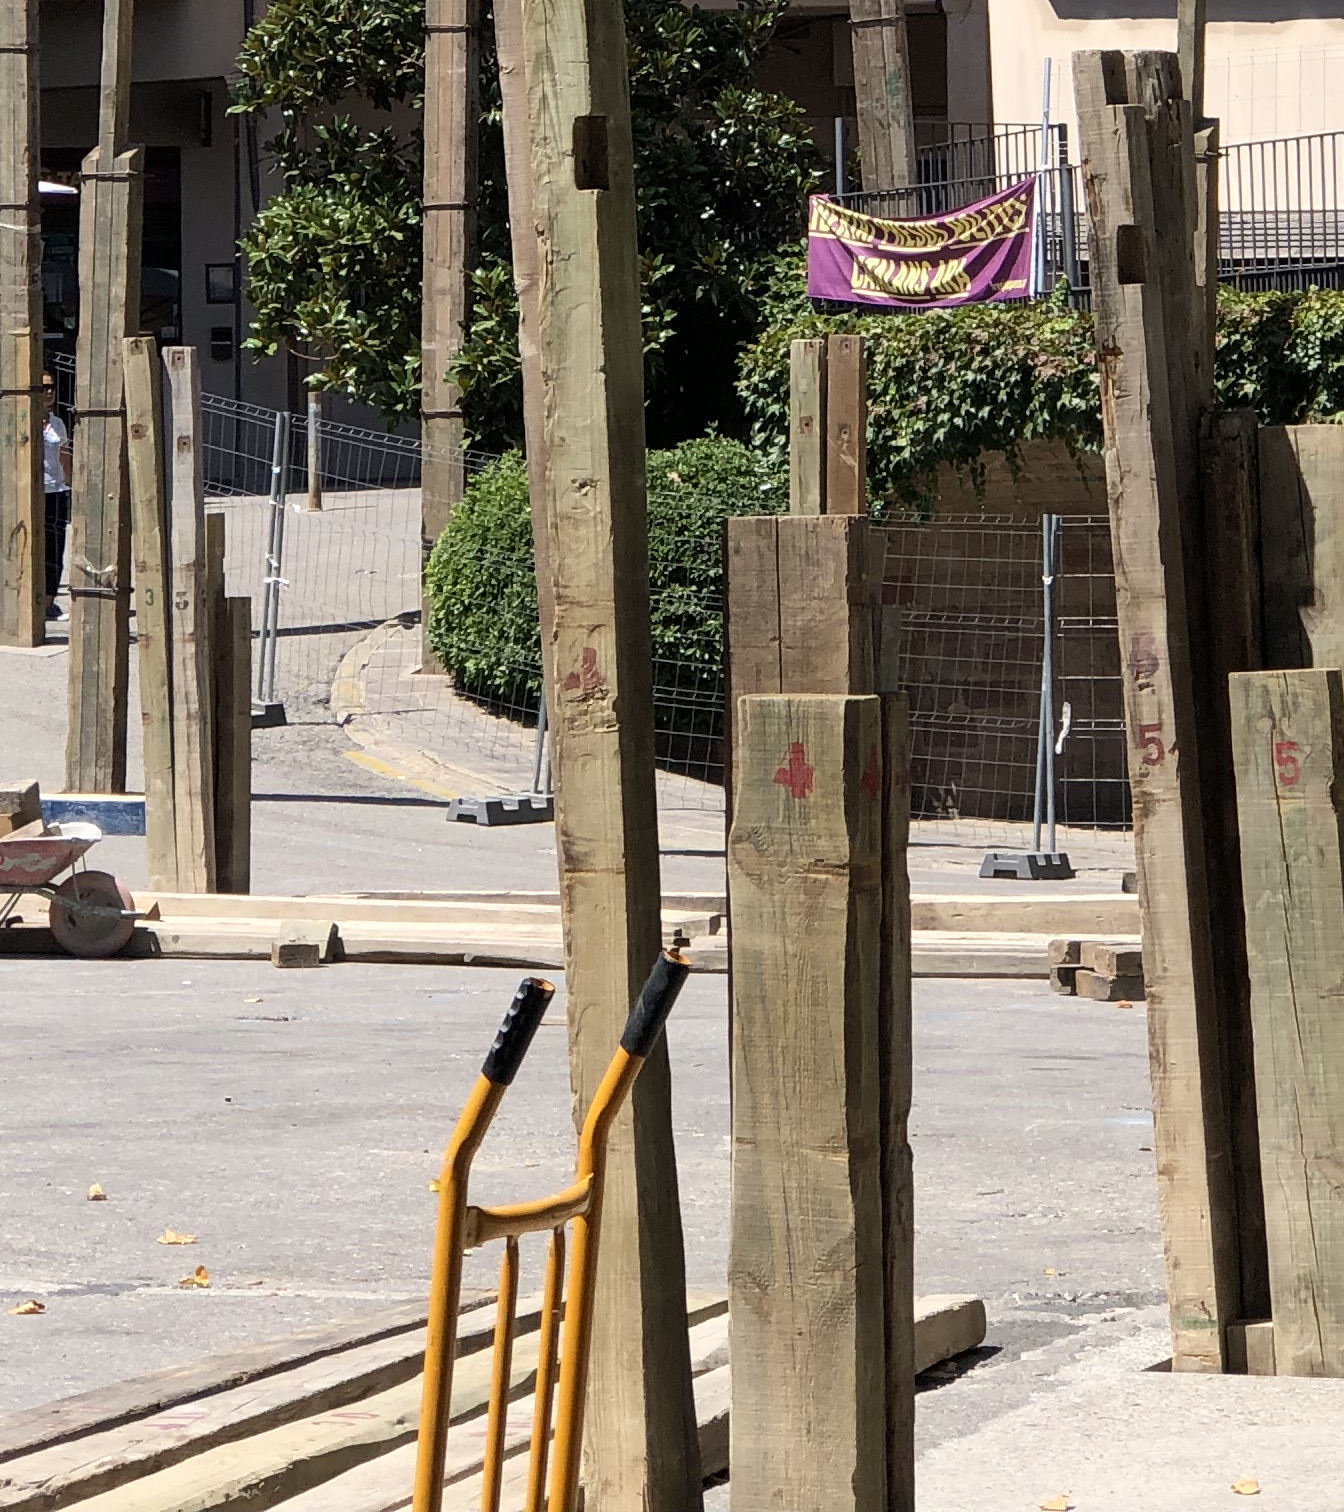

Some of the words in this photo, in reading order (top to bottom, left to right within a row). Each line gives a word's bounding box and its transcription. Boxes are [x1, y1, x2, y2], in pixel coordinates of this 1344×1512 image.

[850, 254, 930, 296] CATALANS
[930, 257, 972, 295] ARA
[144, 587, 155, 607] 3
[174, 590, 190, 611] 5
[1138, 723, 1166, 767] 5
[1274, 740, 1302, 786] 5
